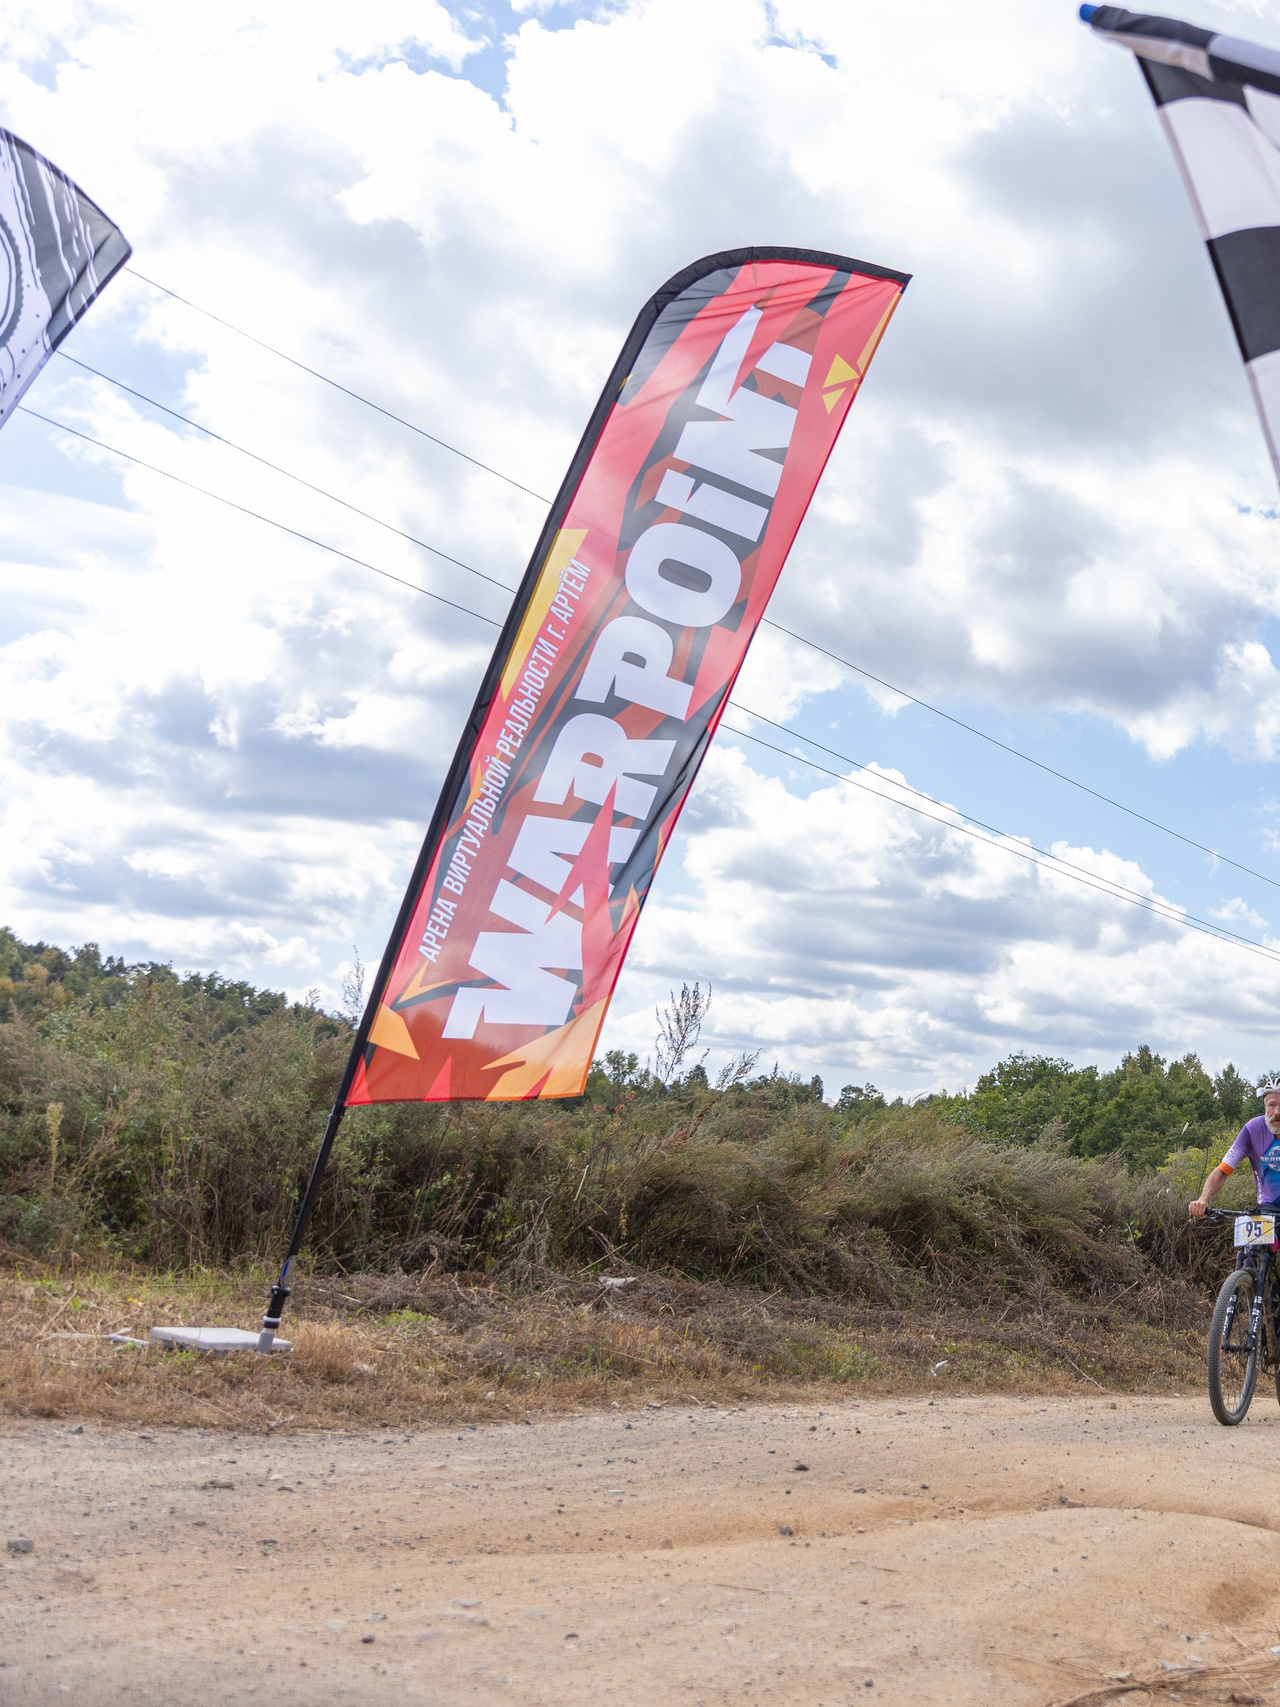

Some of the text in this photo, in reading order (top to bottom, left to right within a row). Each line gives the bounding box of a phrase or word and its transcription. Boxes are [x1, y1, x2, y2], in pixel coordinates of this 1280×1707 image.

[417, 897, 458, 963] АРЕНА
[442, 755, 512, 897] ВИРТУАЛЬНОЙ
[497, 637, 559, 760] РЕАЛЬНОСТИ
[549, 556, 592, 627] АРТЁМ
[1245, 1221, 1262, 1238] 95
